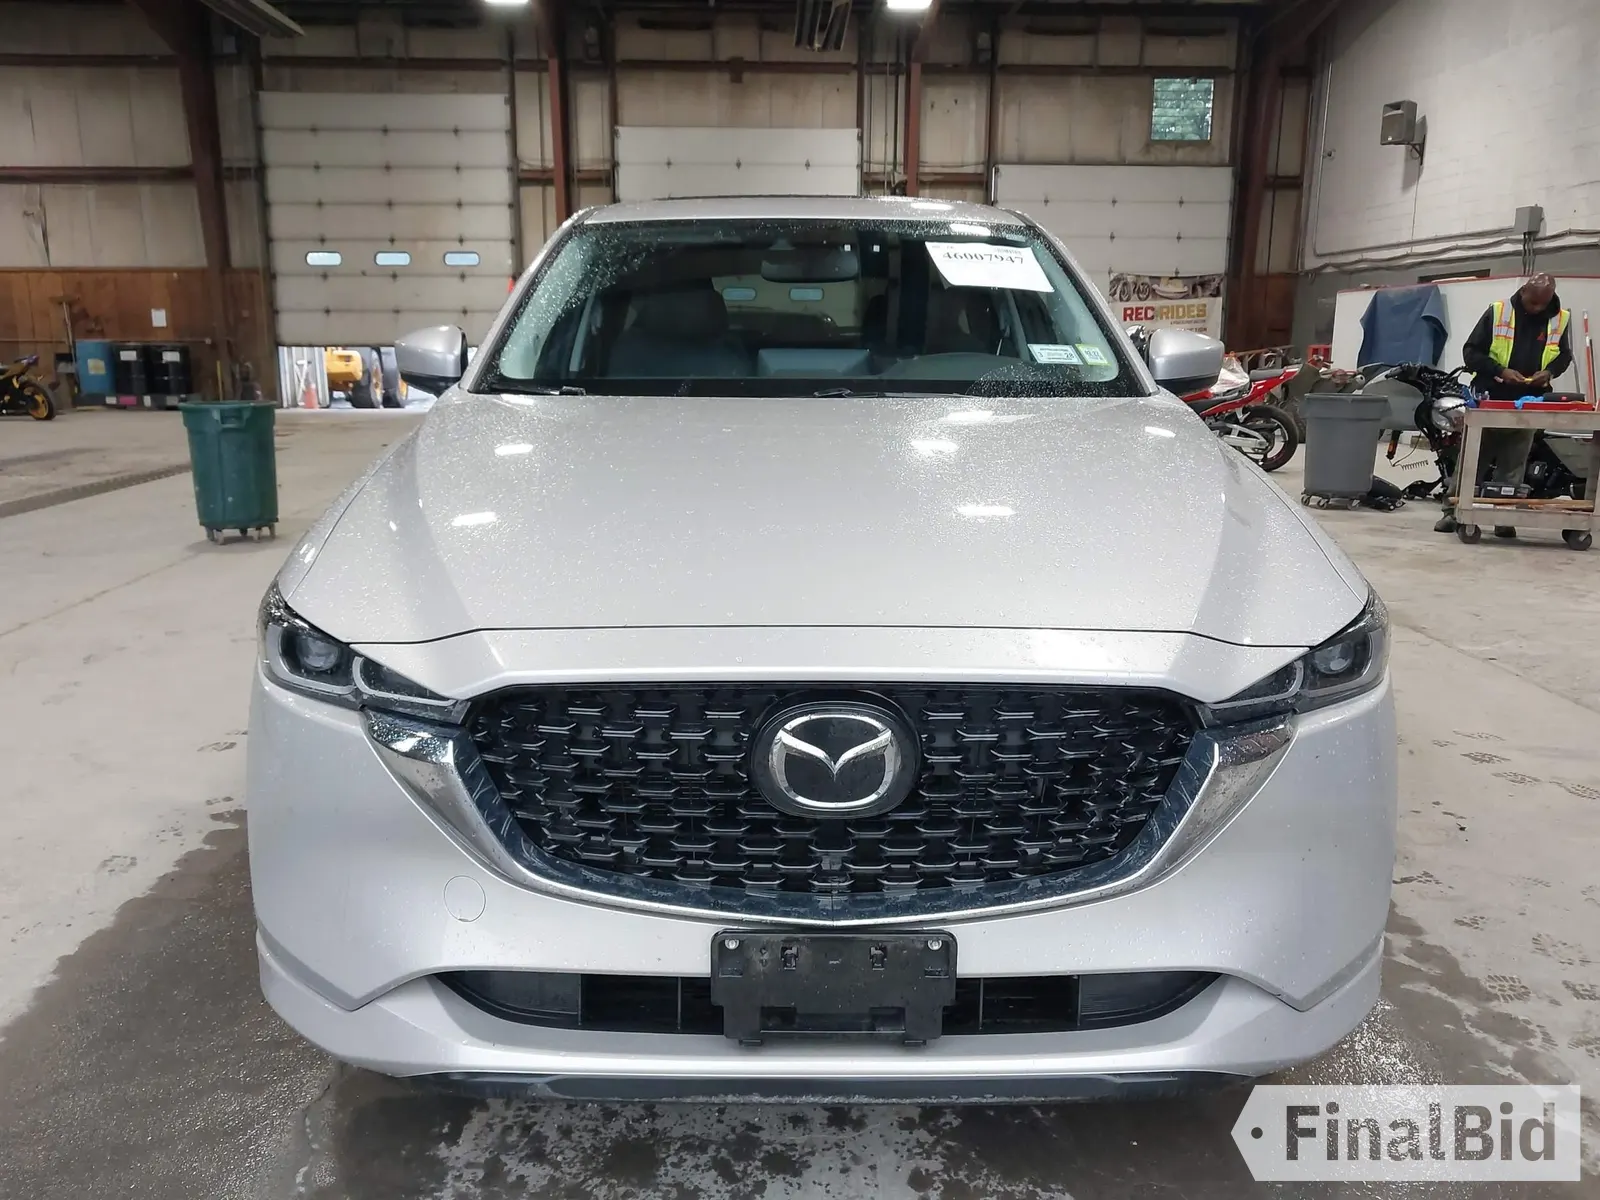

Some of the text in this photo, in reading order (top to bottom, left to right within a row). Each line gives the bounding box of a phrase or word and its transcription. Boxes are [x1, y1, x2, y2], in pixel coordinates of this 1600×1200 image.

[943, 251, 1024, 264] 46007947
[1123, 303, 1207, 321] REC RIDES
